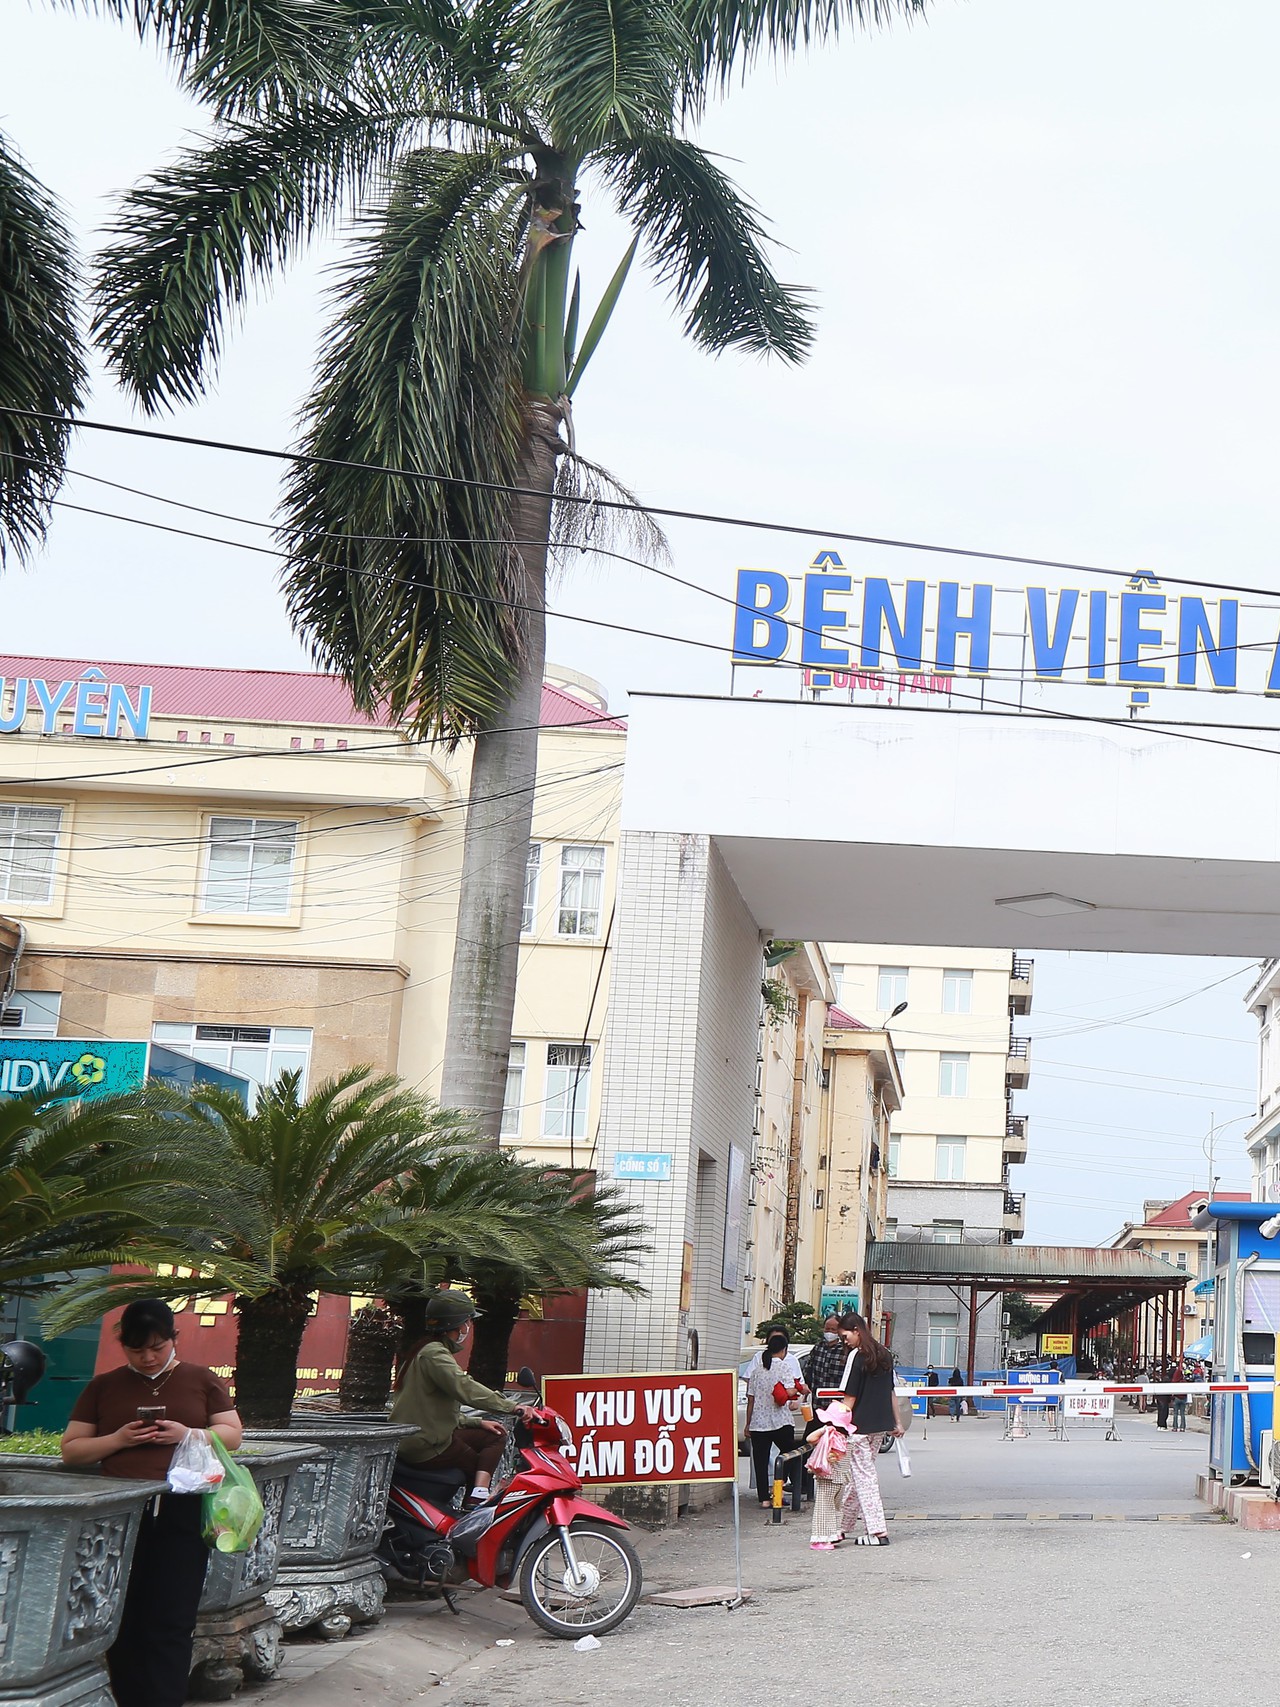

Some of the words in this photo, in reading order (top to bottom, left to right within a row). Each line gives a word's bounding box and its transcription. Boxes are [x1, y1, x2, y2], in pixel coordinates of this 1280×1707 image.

[731, 550, 993, 690] BỆNH
[1025, 569, 1239, 707] VIỆN
[646, 1156, 659, 1172] SỐ
[661, 1161, 667, 1172] 1
[576, 1391, 635, 1427] KHU
[644, 1384, 702, 1425] VỰC
[1069, 1399, 1076, 1409] XE
[1091, 1399, 1097, 1409] XE
[1100, 1396, 1110, 1409] MÁY
[558, 1430, 625, 1477] CẤM
[634, 1424, 676, 1475] ĐỖ
[683, 1436, 721, 1473] XE
